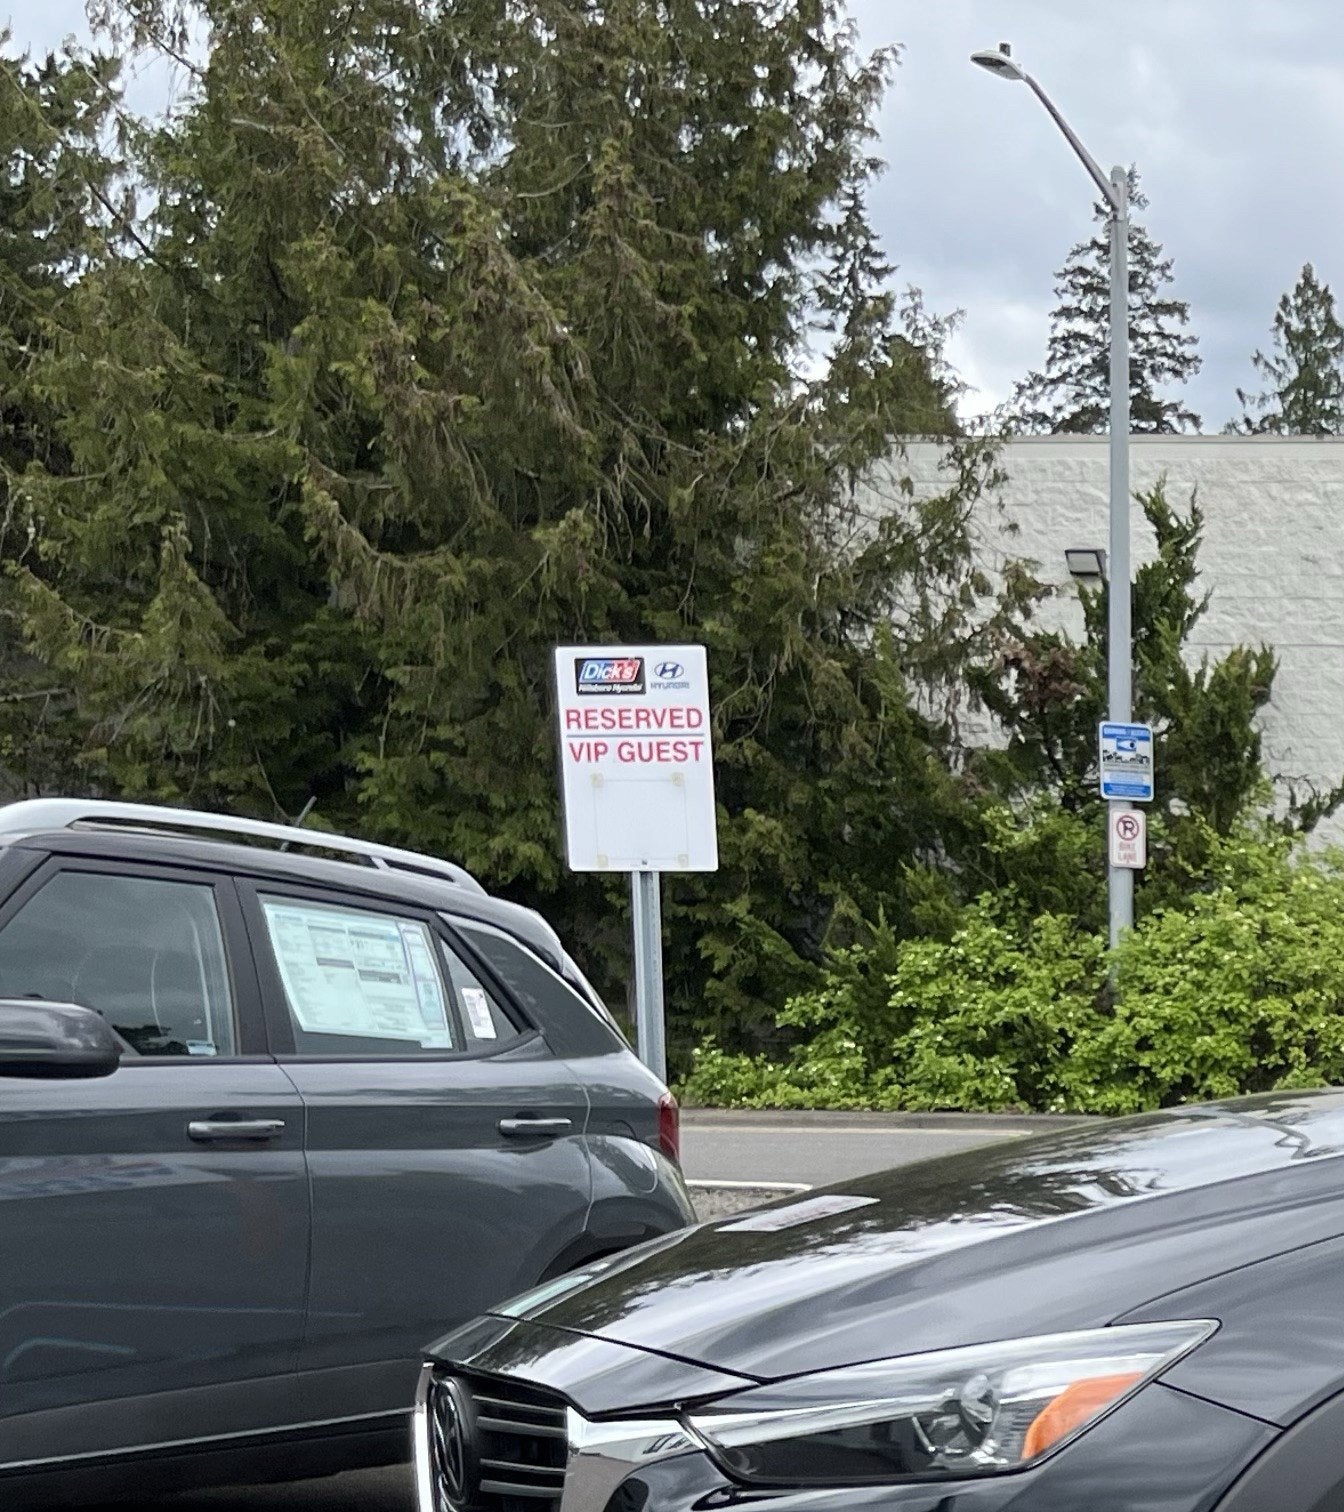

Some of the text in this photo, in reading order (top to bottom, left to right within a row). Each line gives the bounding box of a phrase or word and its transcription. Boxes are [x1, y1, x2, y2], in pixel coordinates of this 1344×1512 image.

[566, 708, 703, 730] RESERVED
[569, 741, 704, 763] VIP GUEST
